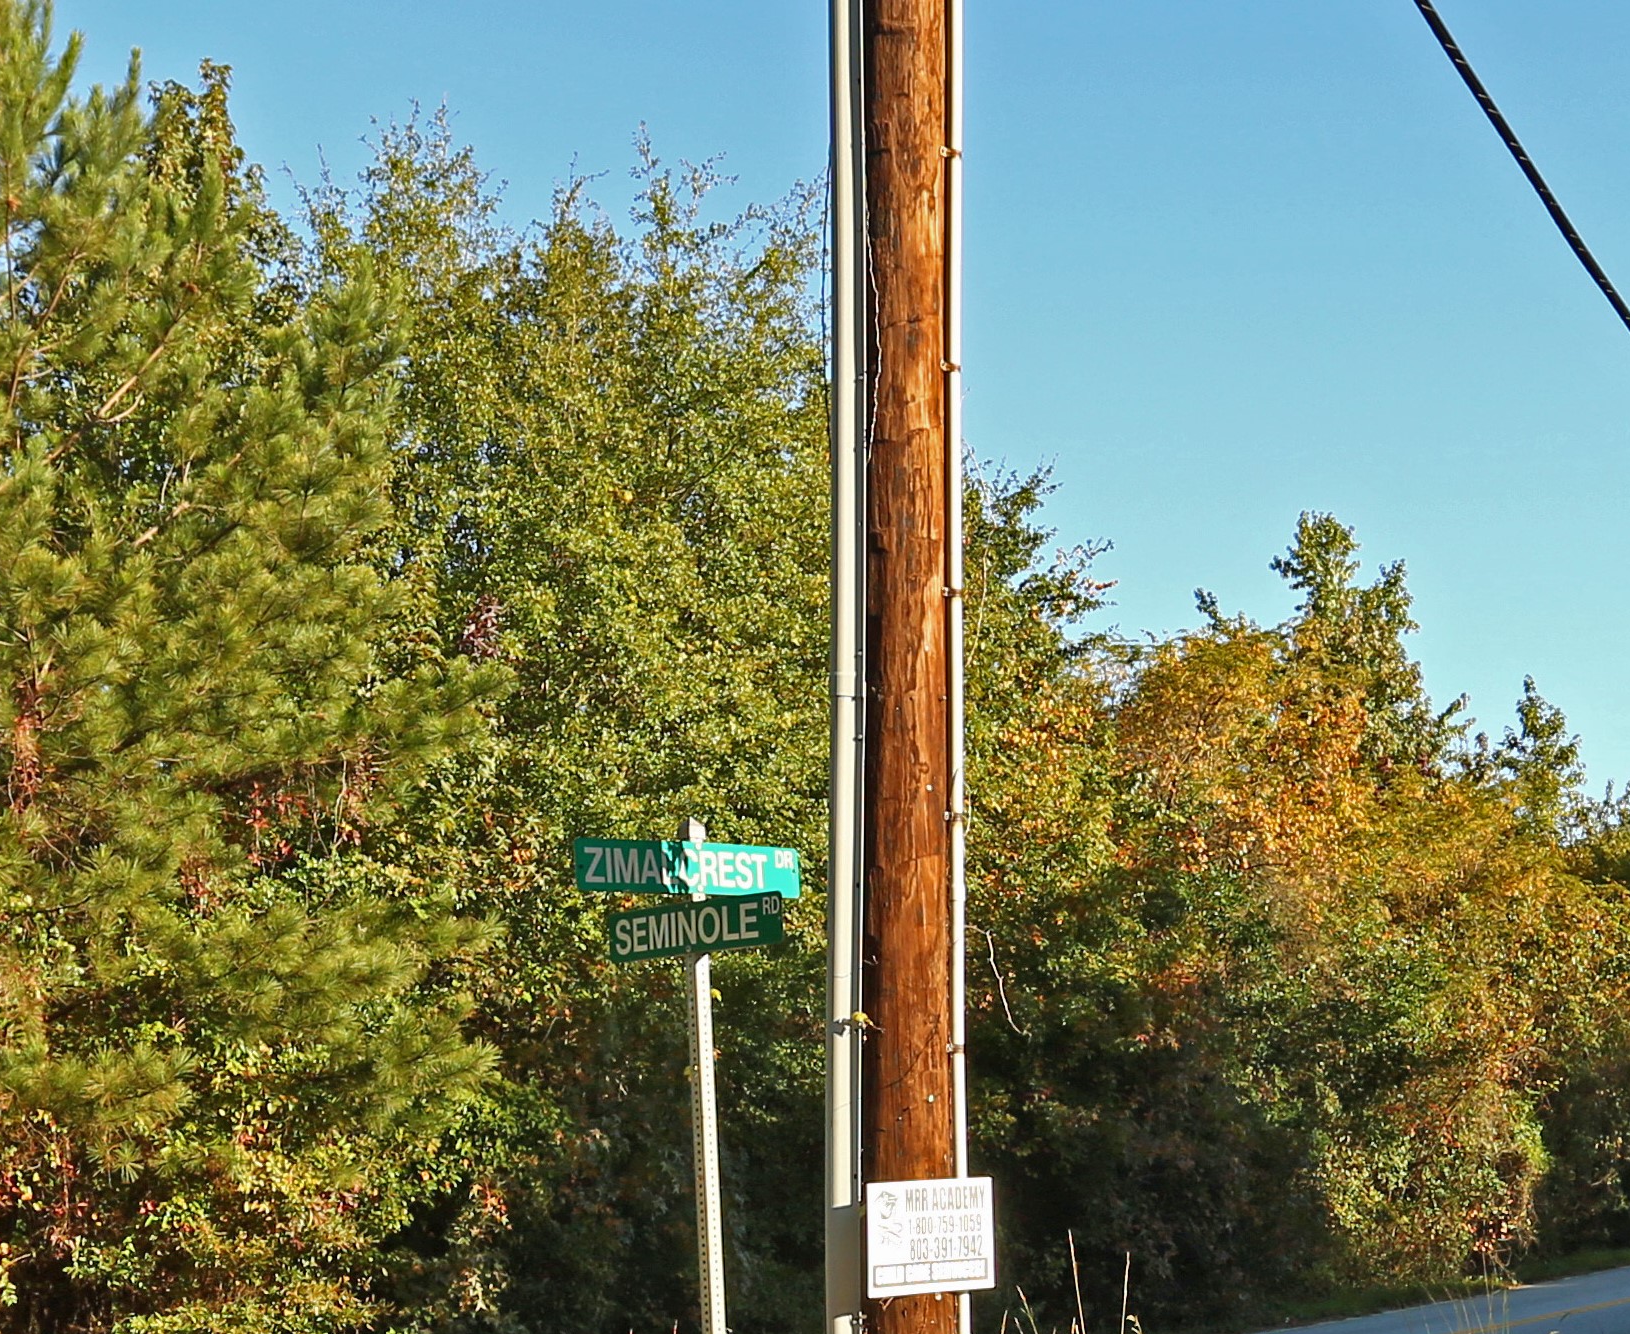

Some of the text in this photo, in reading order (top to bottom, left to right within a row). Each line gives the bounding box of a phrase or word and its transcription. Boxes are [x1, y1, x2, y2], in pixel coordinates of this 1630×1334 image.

[583, 846, 794, 889] ZIMALCREST DR
[615, 895, 781, 956] SEMINOLE RD
[932, 1185, 985, 1211] ACADEMY
[910, 1235, 983, 1261] 803-391-7942
